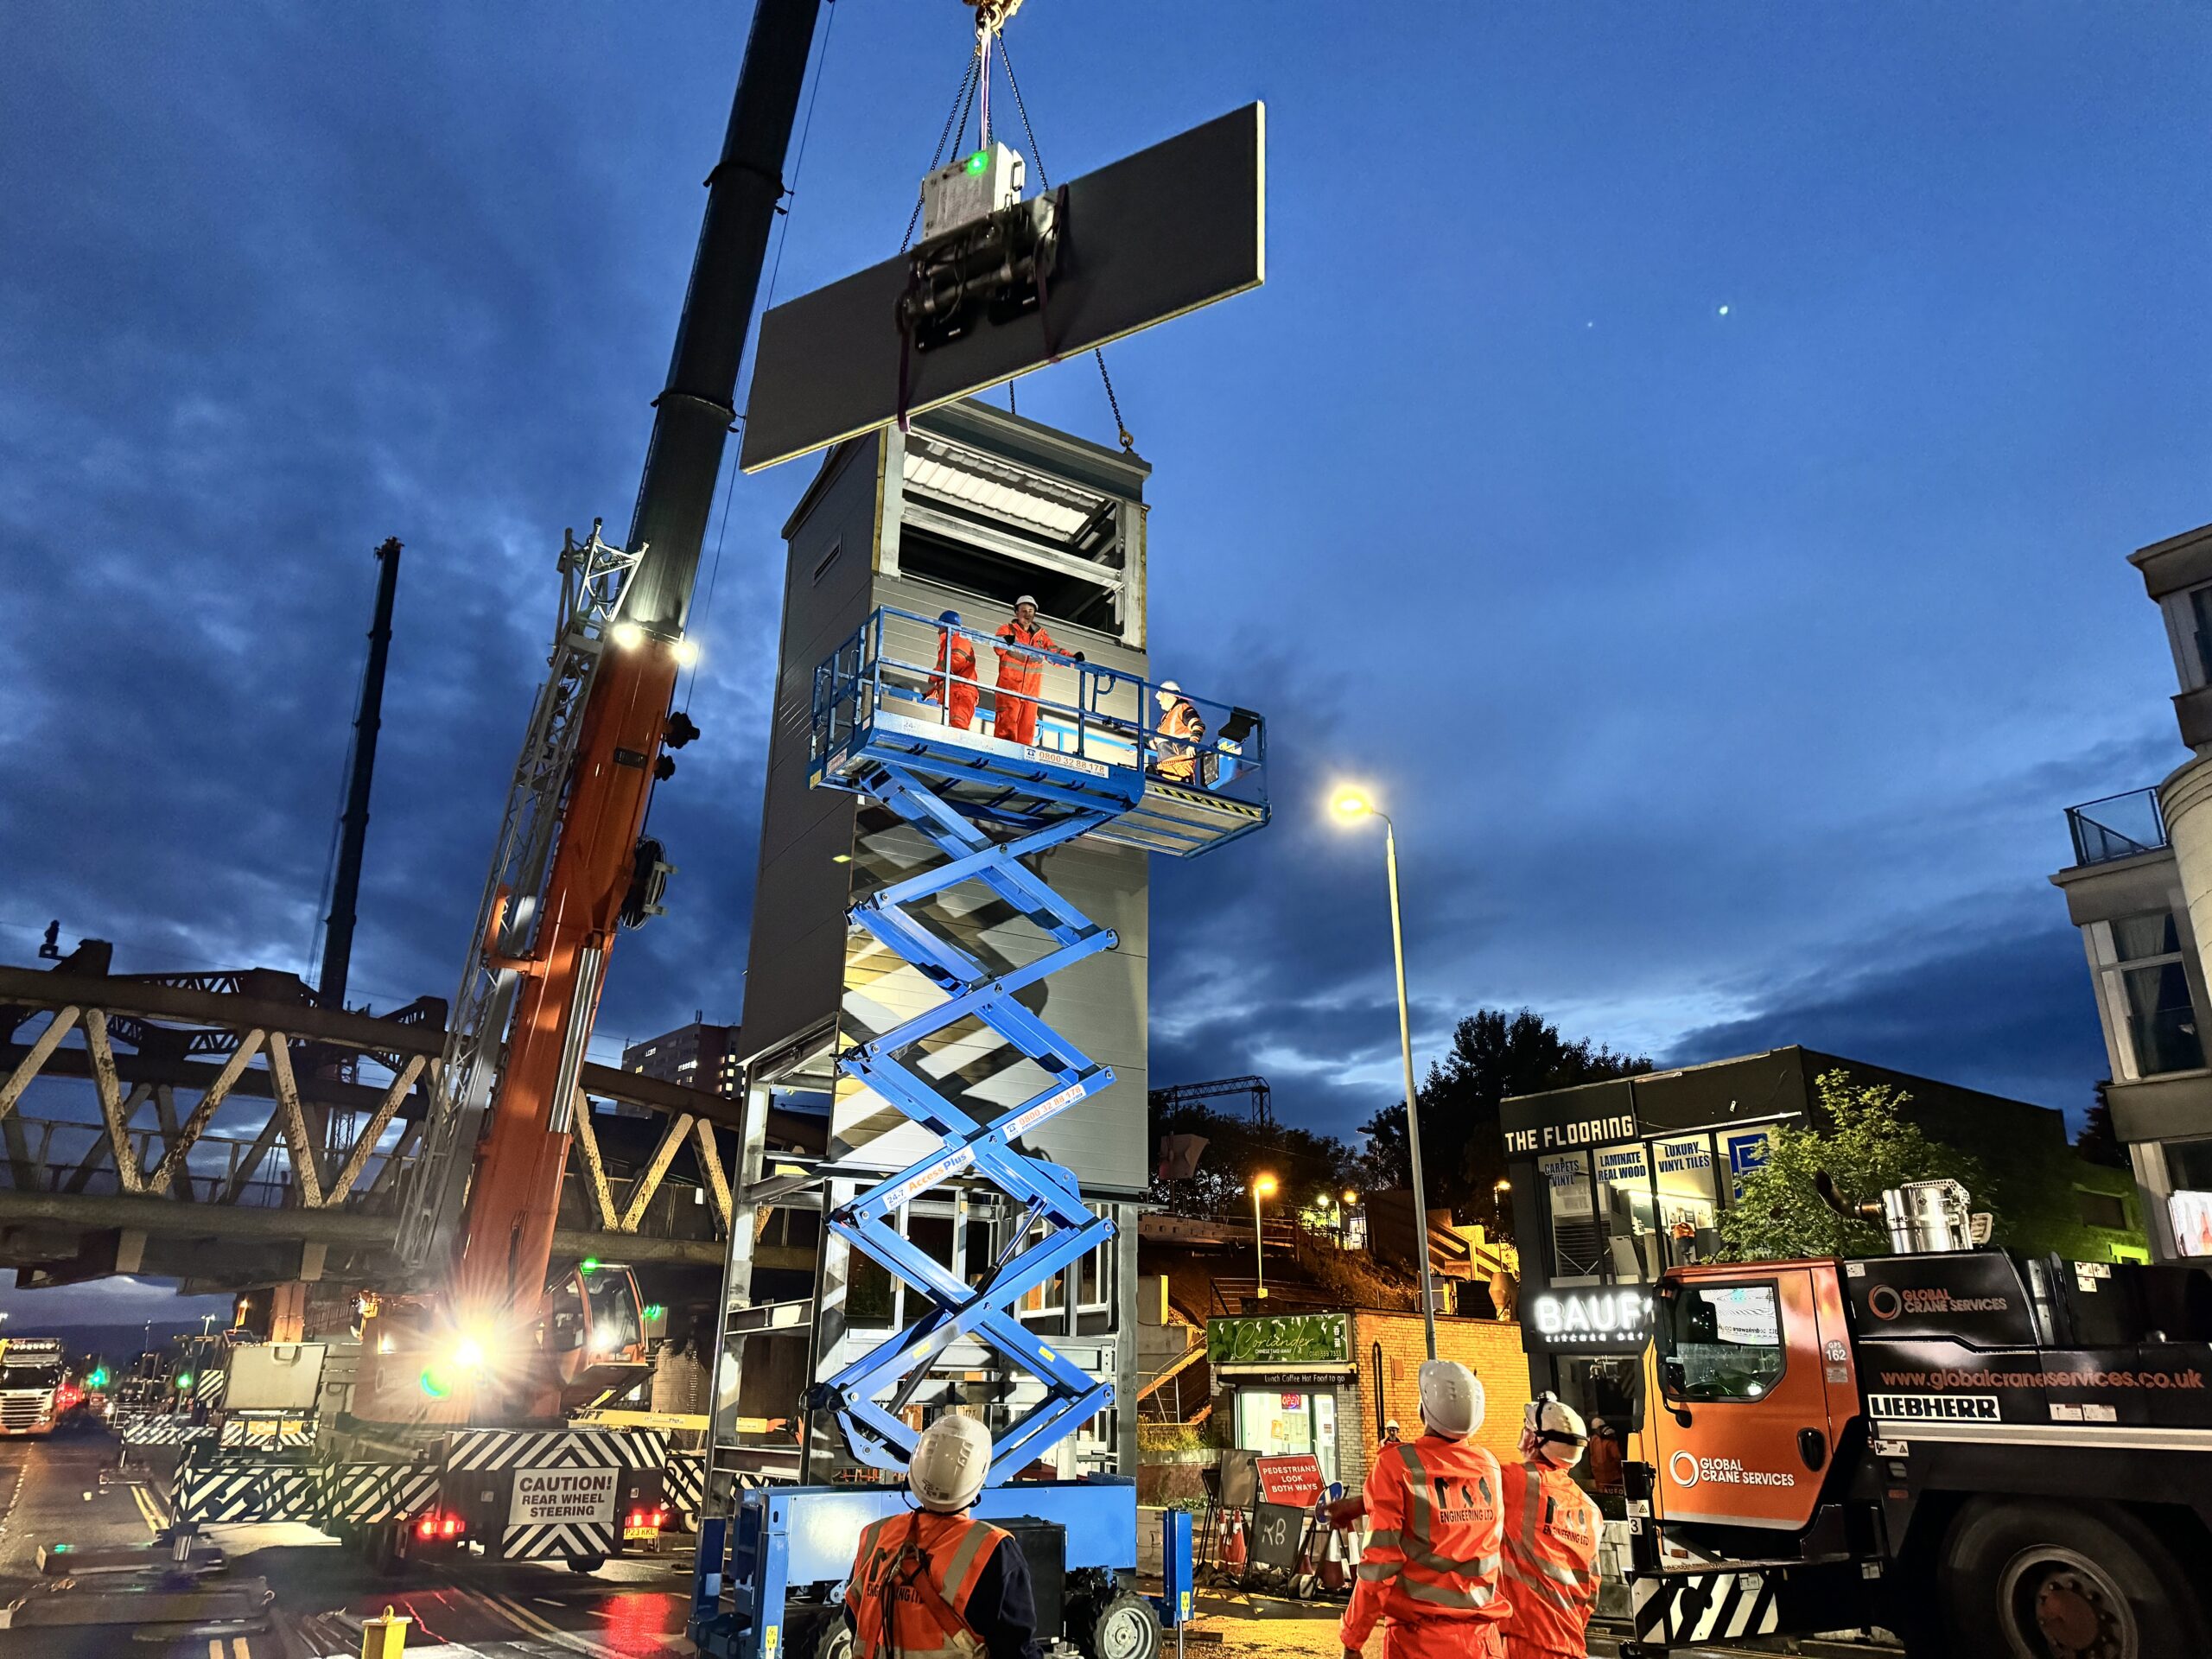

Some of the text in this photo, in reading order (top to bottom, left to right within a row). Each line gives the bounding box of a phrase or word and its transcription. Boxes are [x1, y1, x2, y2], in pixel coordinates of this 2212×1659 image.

[1039, 751, 1061, 763] 0800
[1063, 757, 1074, 766] 32
[1089, 764, 1104, 772] 178
[1019, 1085, 1082, 1126] 0800 32 88 178
[1504, 1115, 1634, 1153] THE FLOORING
[1664, 1141, 1700, 1158] LUXURY
[1599, 1151, 1642, 1167] LAMINATE
[1658, 1155, 1710, 1173] VINYL TILES
[1544, 1160, 1580, 1175] CARPETS
[1598, 1165, 1646, 1181] REAL WOOD
[1551, 1174, 1574, 1187] VINYL
[1902, 1288, 1951, 1301] GLOBAL
[1904, 1298, 2008, 1313] CRANE SERVICES
[1234, 1322, 1313, 1359] Coriander
[1826, 1350, 1847, 1361] 162
[1313, 1374, 1328, 1382] Food
[1879, 1368, 2205, 1390] www.globalcraneservices.co.uk
[1871, 1396, 1998, 1419] LIEBHERR
[1262, 1465, 1317, 1476] PEDESTRIANS
[1700, 1458, 1744, 1471] GLOBAL
[519, 1476, 613, 1492] CAUTION!
[1700, 1471, 1795, 1487] CRANE SERVICES
[1271, 1483, 1318, 1493] BOTH WAYS
[522, 1493, 605, 1505] REAR WHEEL
[530, 1505, 594, 1517] STEERING
[1440, 1509, 1494, 1523] ENGINEERING LTD
[1630, 1519, 1639, 1533] 3
[1580, 1534, 1590, 1546] LTD
